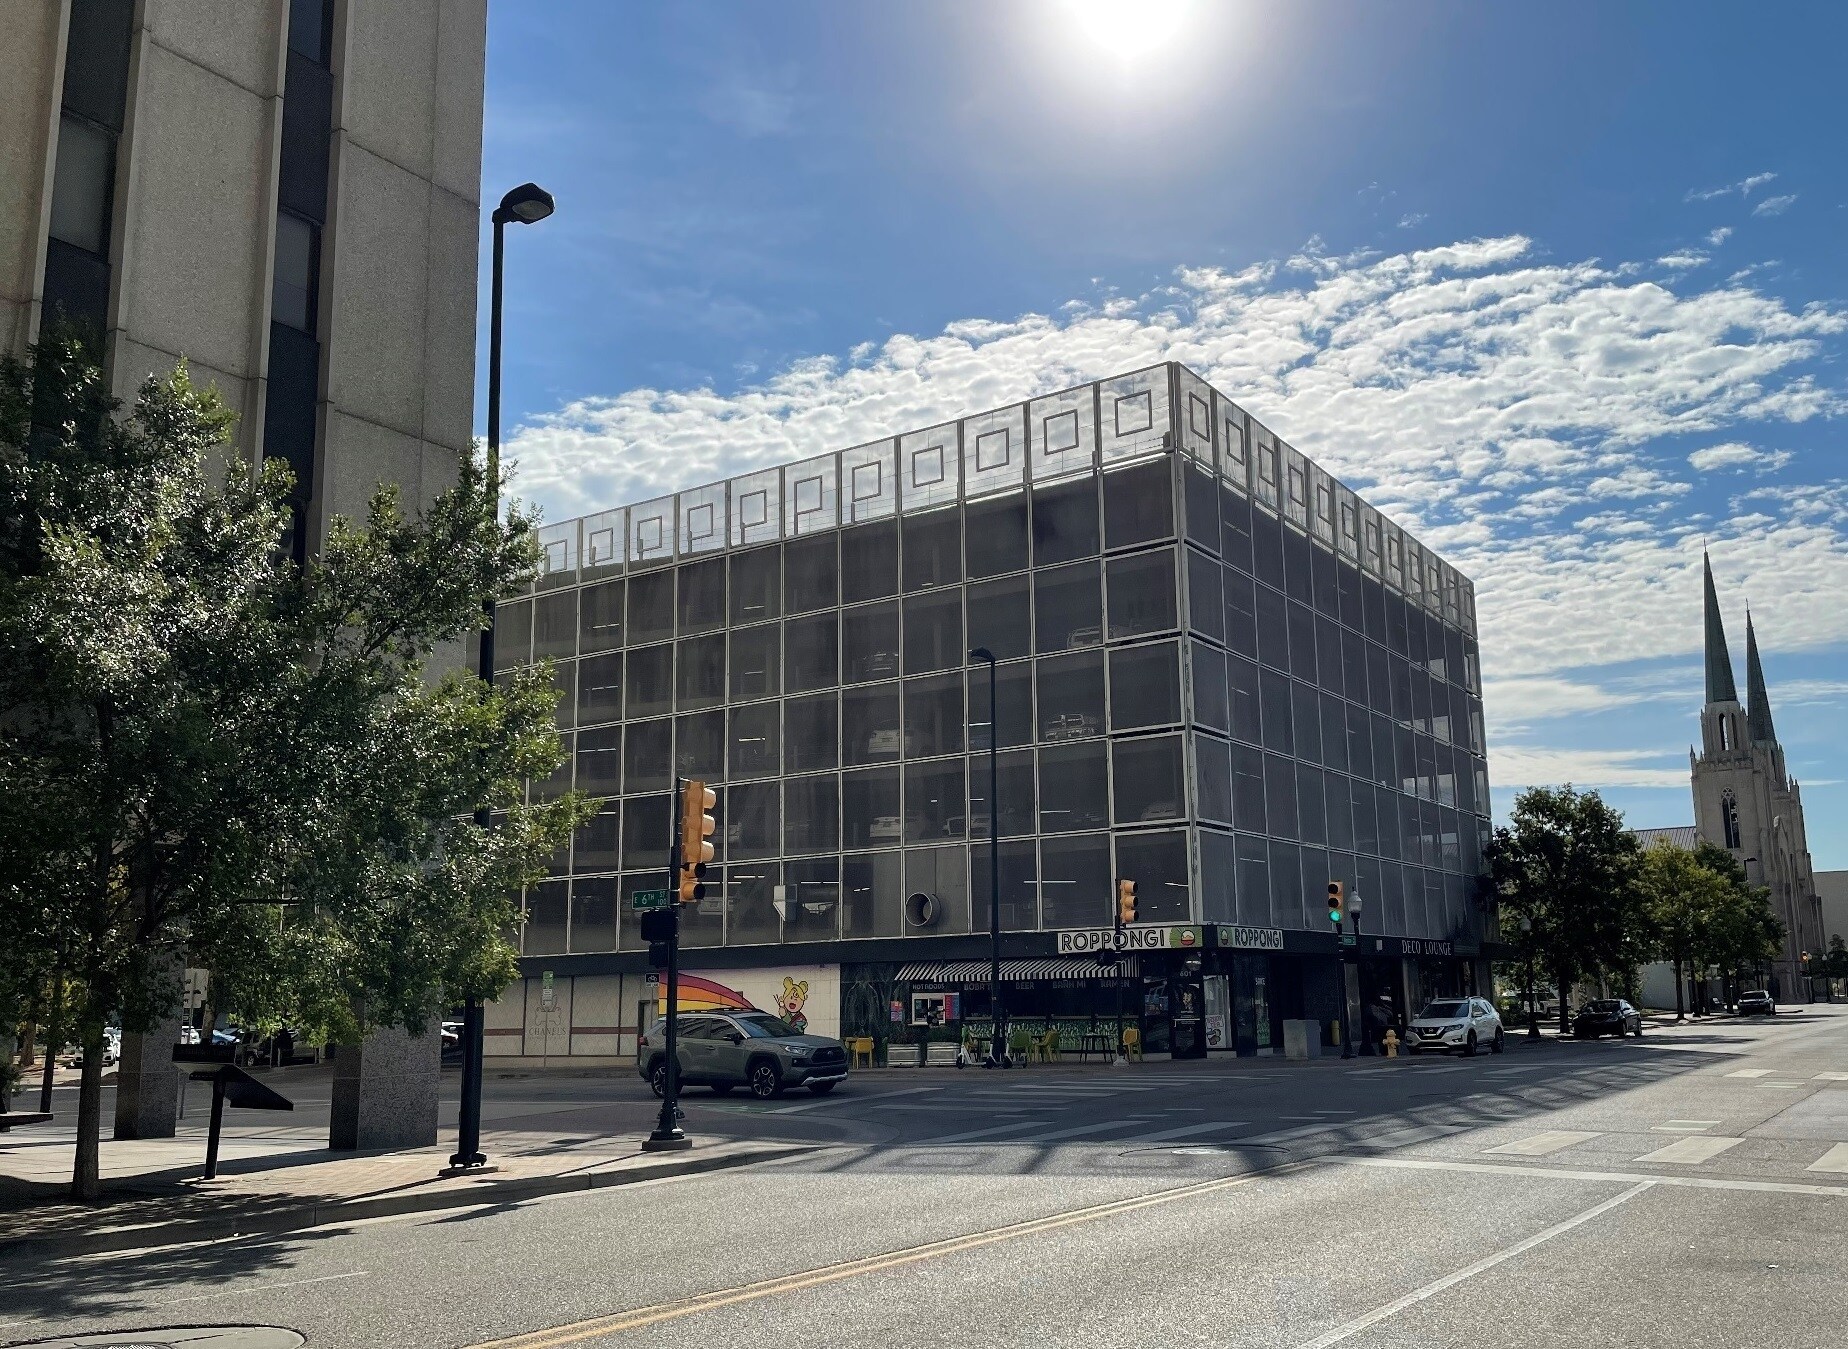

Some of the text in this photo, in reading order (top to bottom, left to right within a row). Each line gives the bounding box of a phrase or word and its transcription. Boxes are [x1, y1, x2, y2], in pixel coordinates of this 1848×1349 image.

[634, 896, 638, 904] E
[659, 890, 666, 898] ST
[1061, 929, 1165, 951] ROPPONGI
[1234, 928, 1282, 947] ROPPONGI
[1401, 939, 1452, 956] DECO LOUNGE
[1015, 981, 1035, 990] BEER
